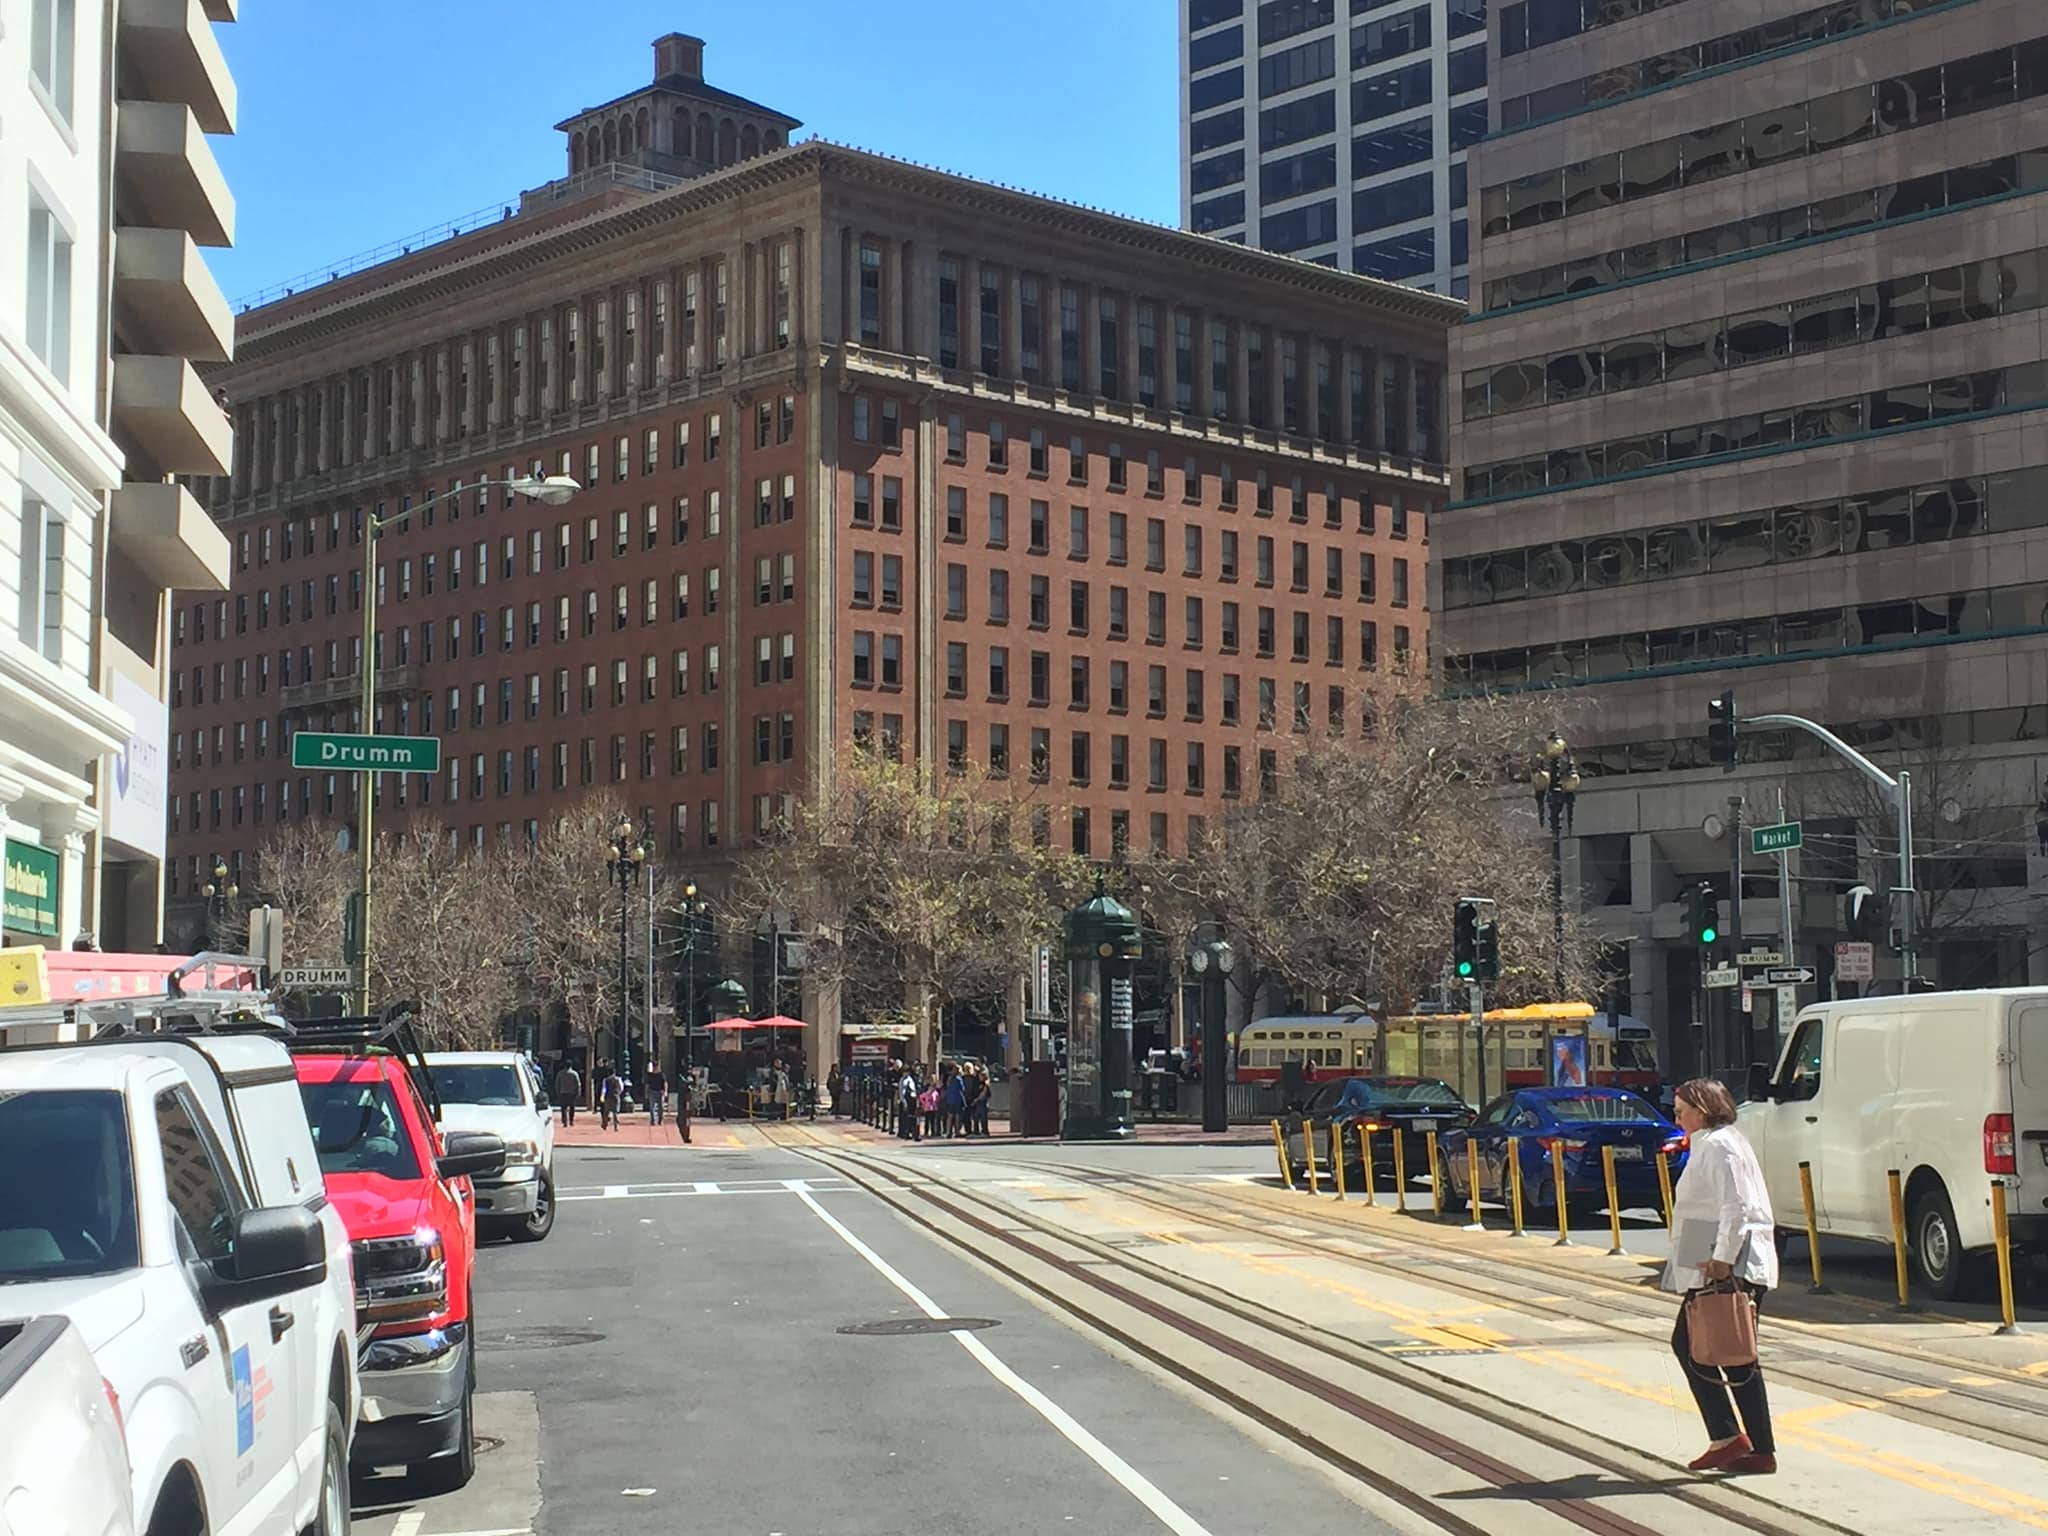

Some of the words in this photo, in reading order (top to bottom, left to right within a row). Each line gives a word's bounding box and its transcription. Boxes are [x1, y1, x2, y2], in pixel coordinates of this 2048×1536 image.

[321, 742, 412, 762] Drumm
[1762, 831, 1791, 845] Market
[284, 971, 347, 983] DRUMM
